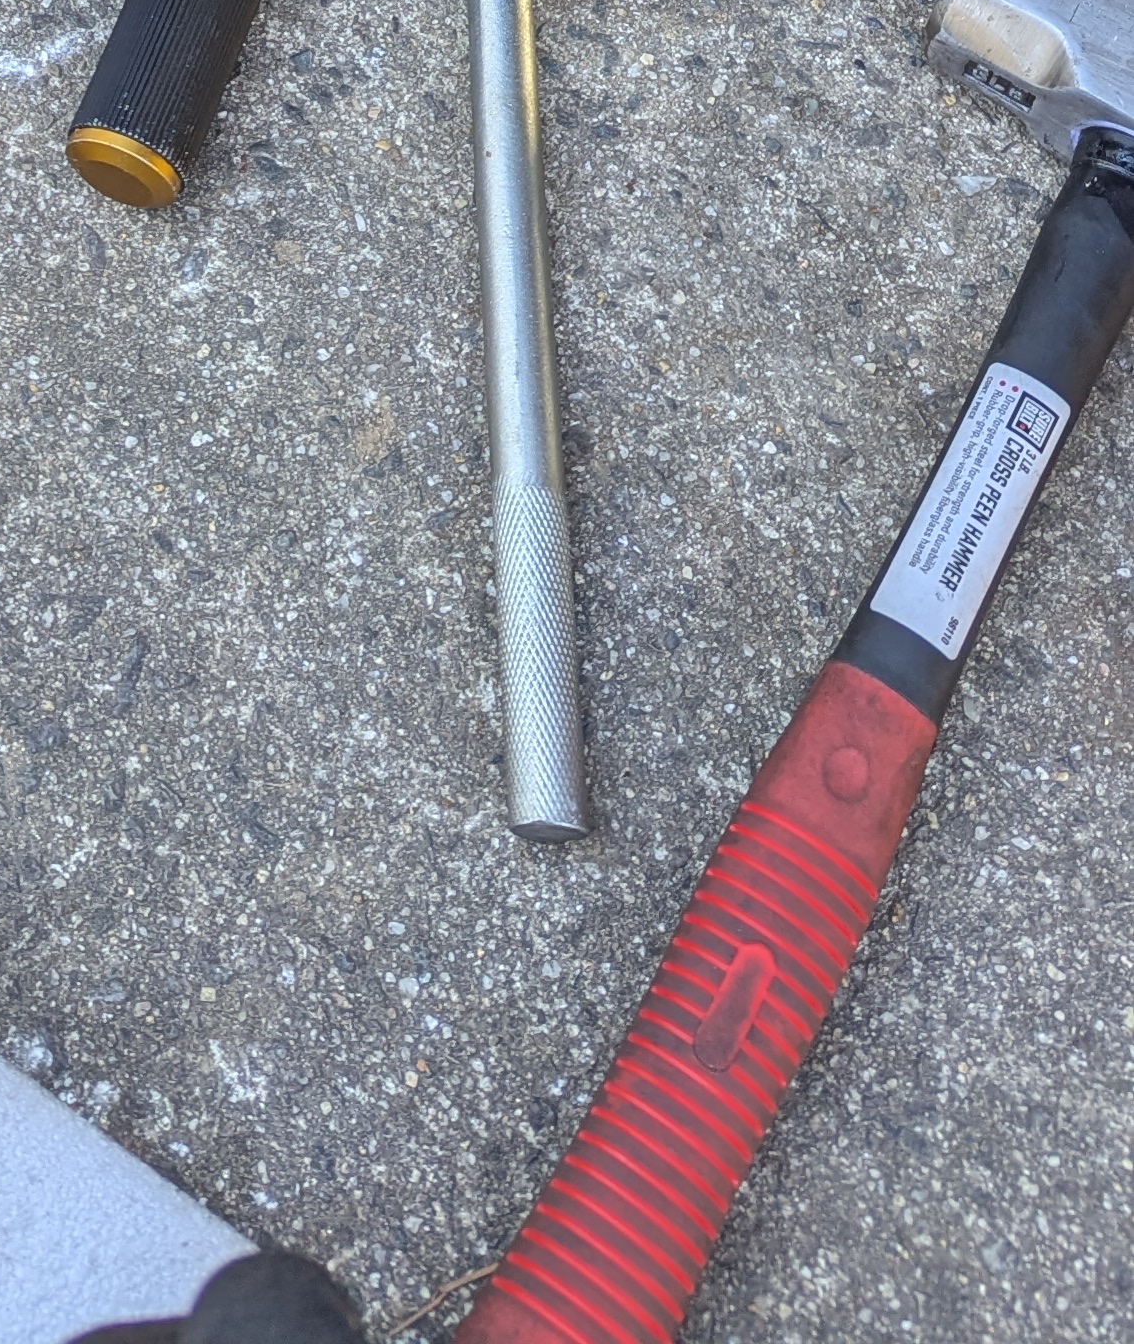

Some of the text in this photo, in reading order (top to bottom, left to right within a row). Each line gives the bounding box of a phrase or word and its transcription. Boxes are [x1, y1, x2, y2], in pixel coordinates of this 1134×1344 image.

[1016, 448, 1037, 475] 3 LB.
[1017, 400, 1040, 430] BILT
[1027, 408, 1051, 443] SURE
[907, 388, 1003, 568] Rubber-grip, high-visibility fiberglass handle
[918, 393, 1016, 574] Drop-forged steel for strength and durability
[937, 435, 1024, 593] CROSS PEEN HAMMER
